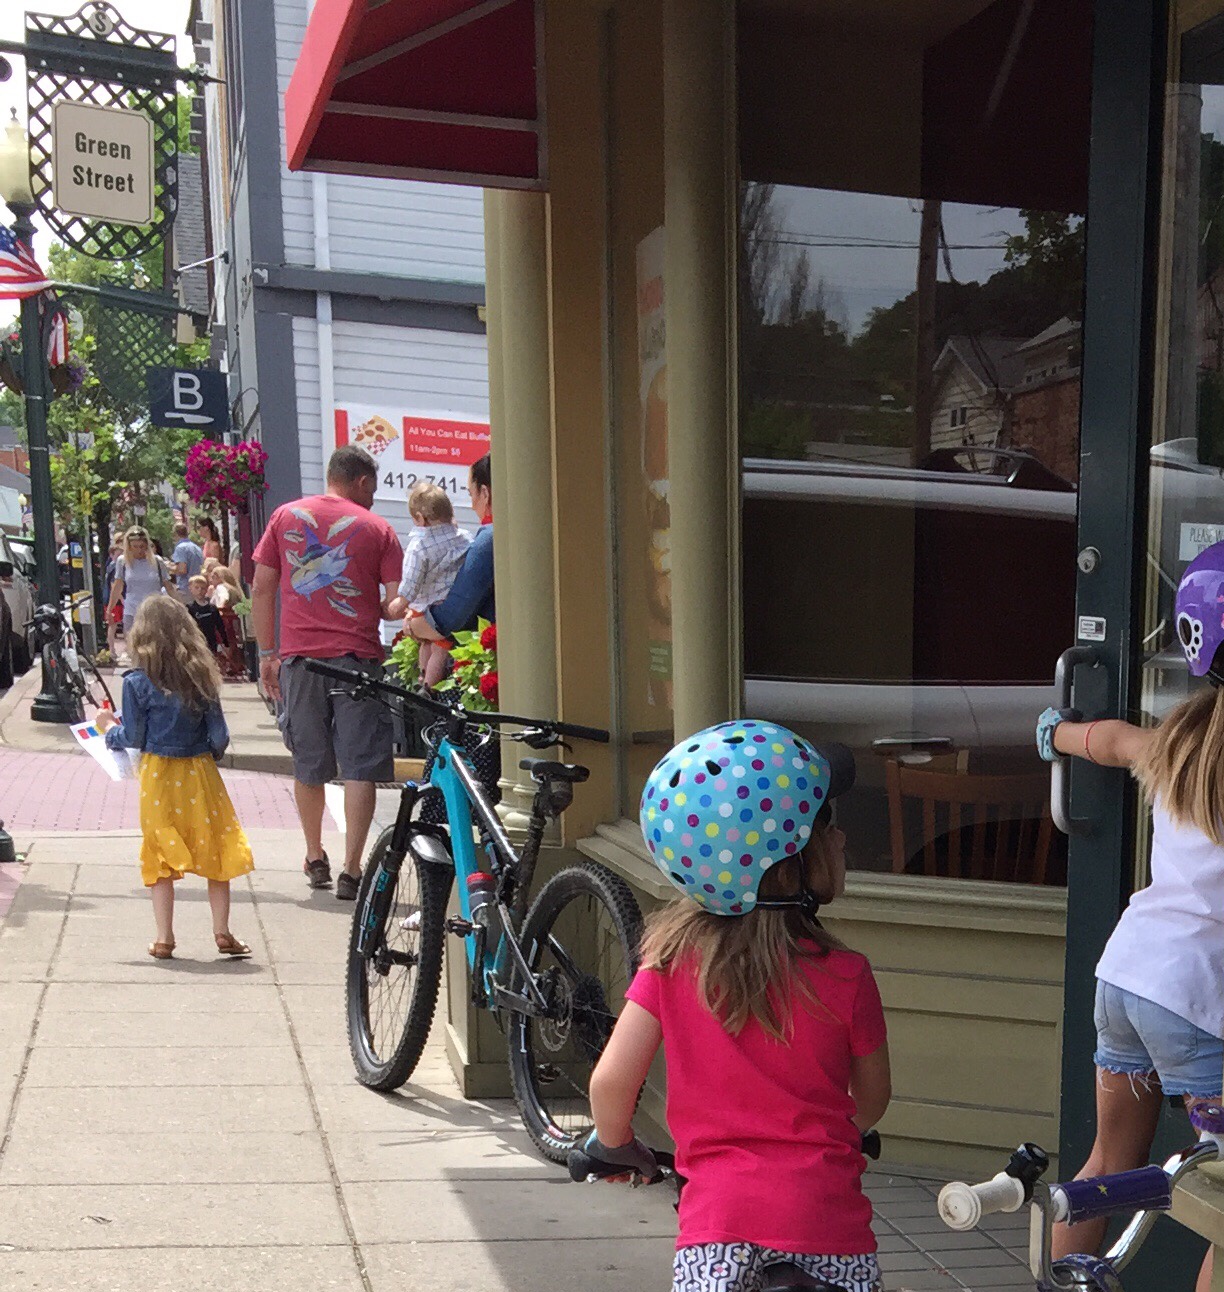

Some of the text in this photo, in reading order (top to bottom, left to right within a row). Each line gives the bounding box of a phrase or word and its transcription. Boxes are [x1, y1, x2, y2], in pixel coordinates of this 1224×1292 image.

[75, 131, 131, 160] Green
[73, 164, 134, 194] Street
[173, 372, 204, 410] B
[408, 426, 419, 435] All
[420, 427, 436, 436] You
[437, 428, 453, 437] Can
[454, 430, 468, 439] Eat
